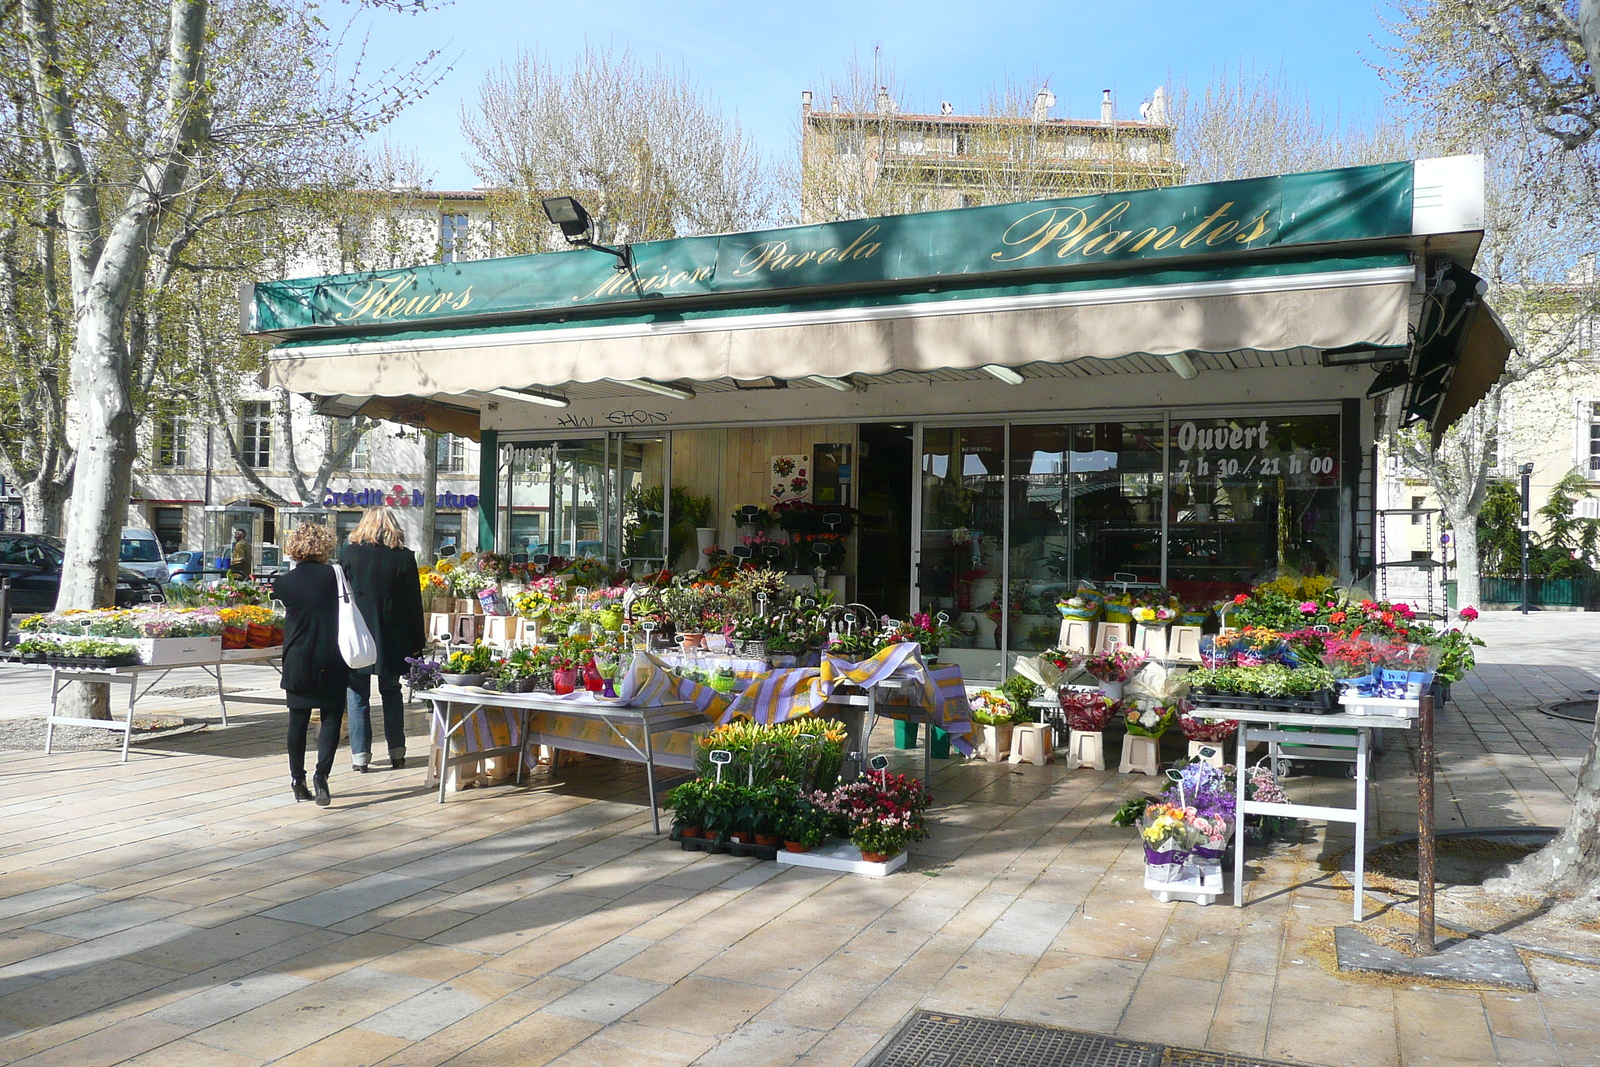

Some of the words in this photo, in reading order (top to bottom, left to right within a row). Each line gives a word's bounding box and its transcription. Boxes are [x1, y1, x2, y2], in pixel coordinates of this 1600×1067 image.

[335, 272, 475, 320] Fleurs
[572, 263, 712, 302] Maison
[732, 224, 880, 278] Parola
[990, 200, 1273, 262] Plantes
[1177, 420, 1269, 451] Ouvert
[502, 441, 560, 466] Ouvert
[1178, 459, 1190, 477] 7
[1197, 456, 1209, 476] h
[1289, 454, 1302, 475] h
[1310, 456, 1333, 474] 00
